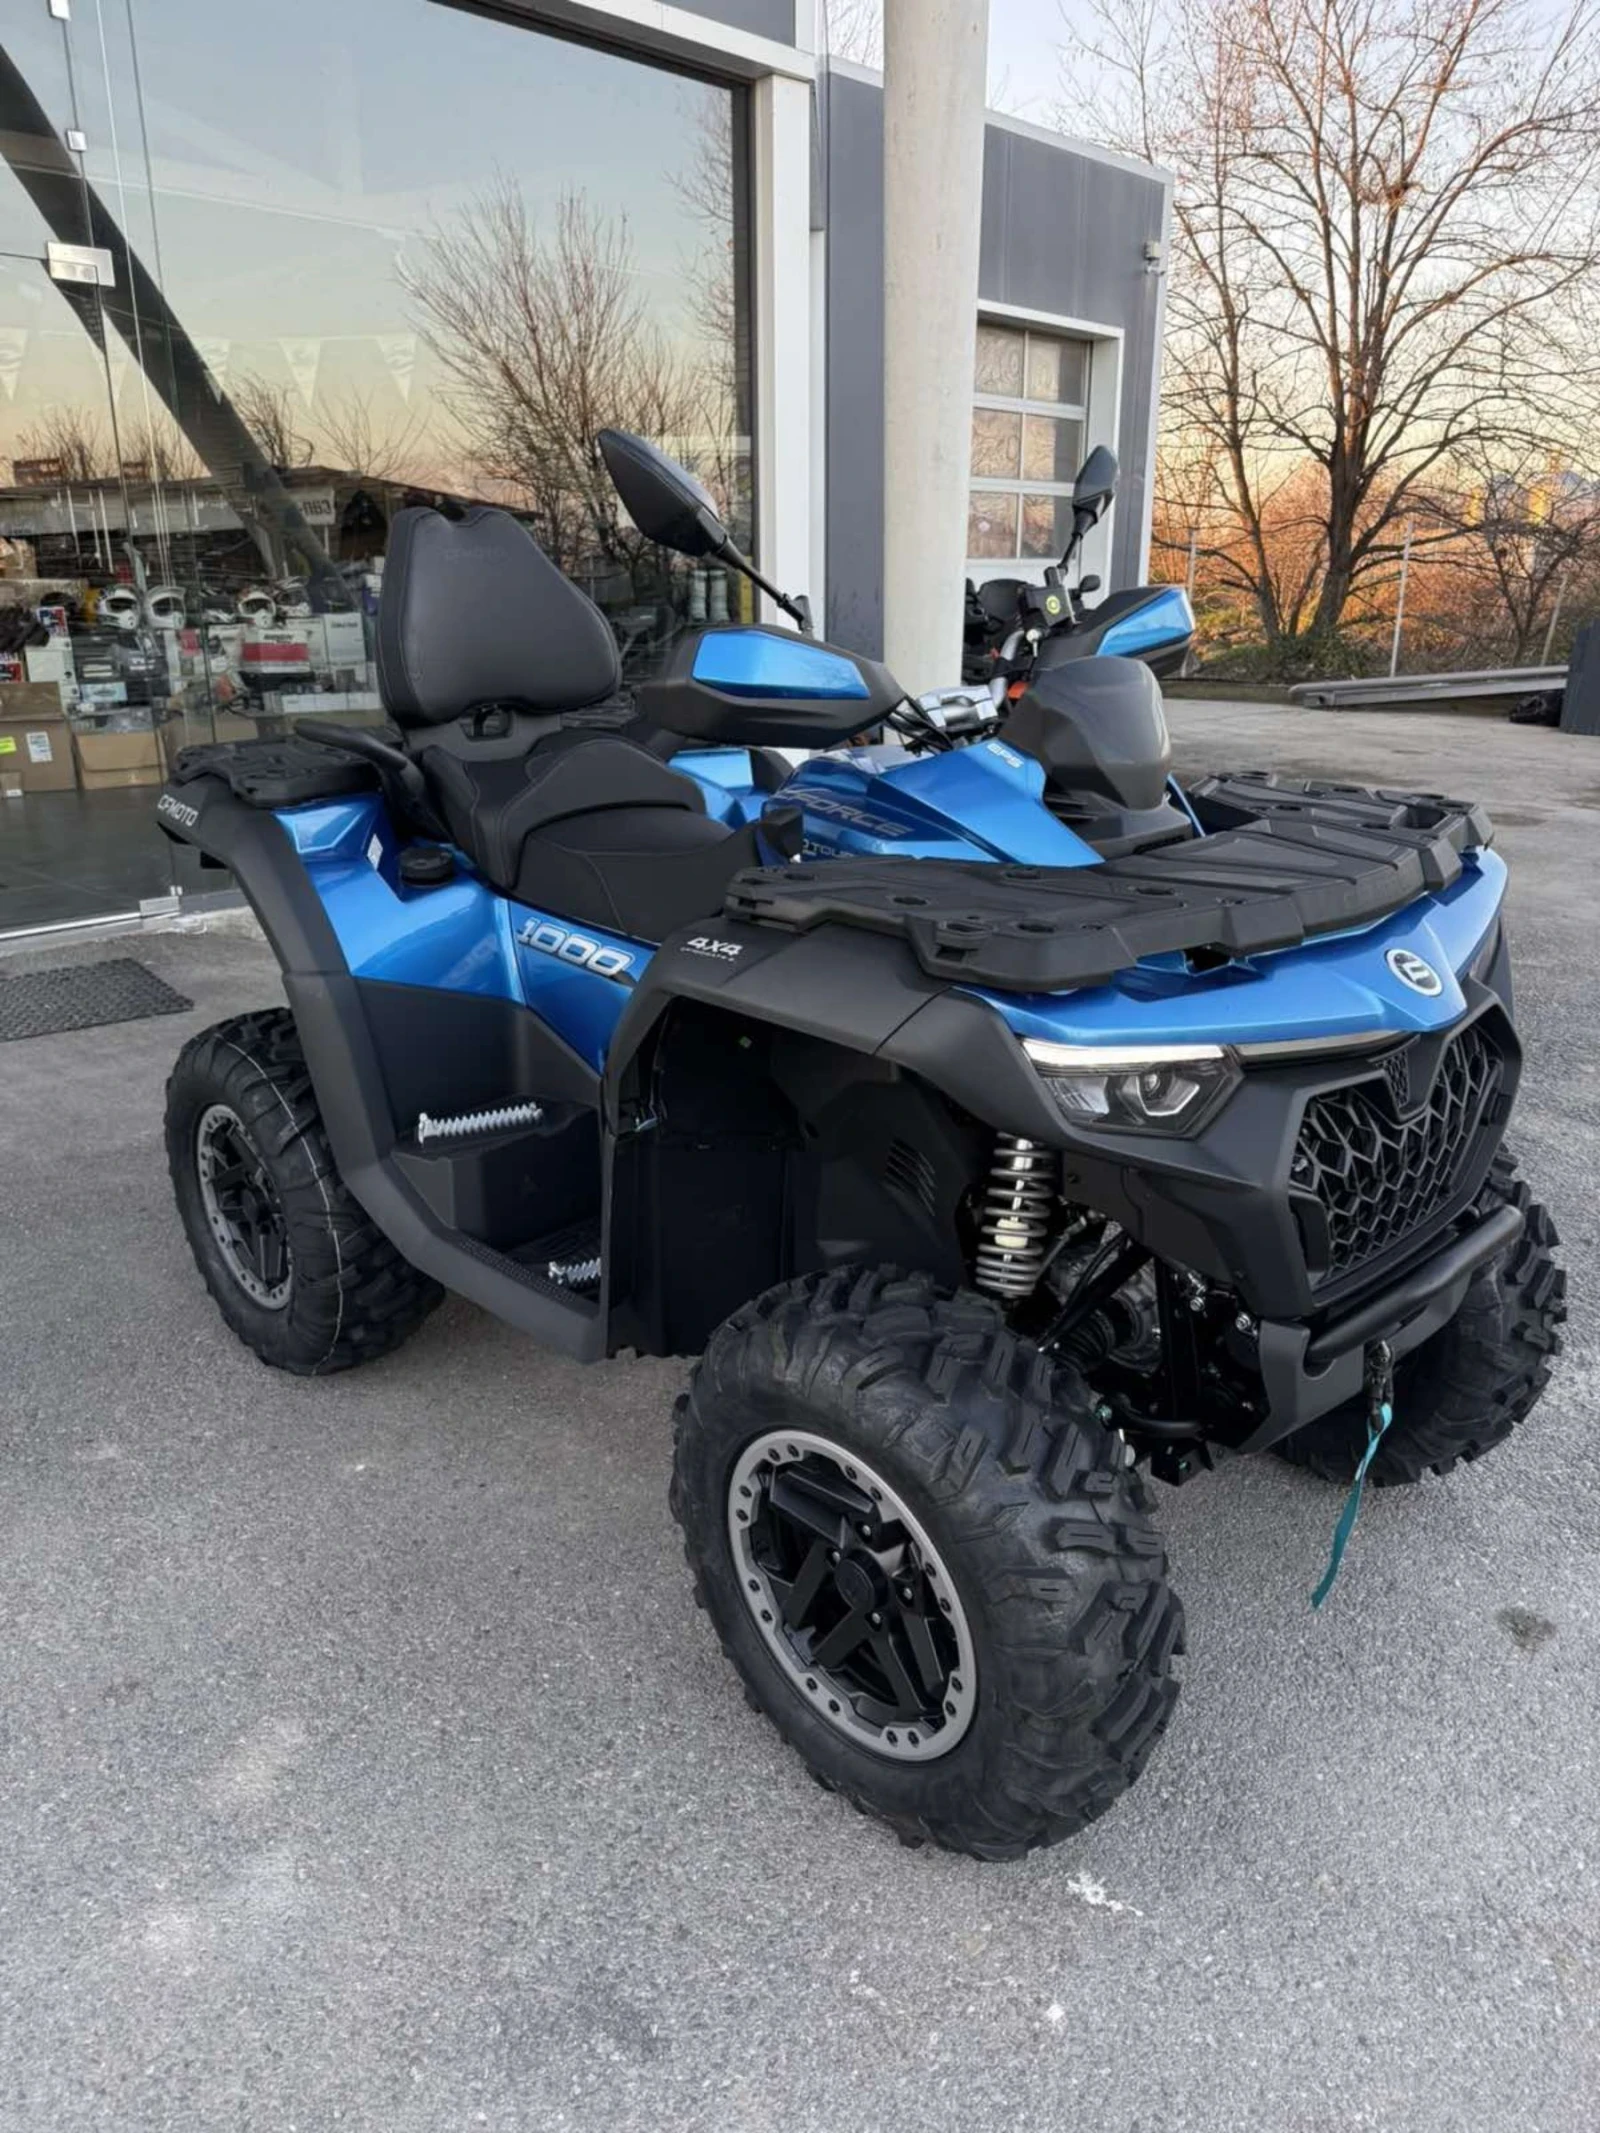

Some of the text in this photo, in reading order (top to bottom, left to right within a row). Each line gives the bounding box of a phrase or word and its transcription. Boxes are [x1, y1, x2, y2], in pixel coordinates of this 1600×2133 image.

[987, 743, 1024, 768] EPS
[157, 794, 199, 827] CFMOTO
[517, 917, 635, 977] 1000
